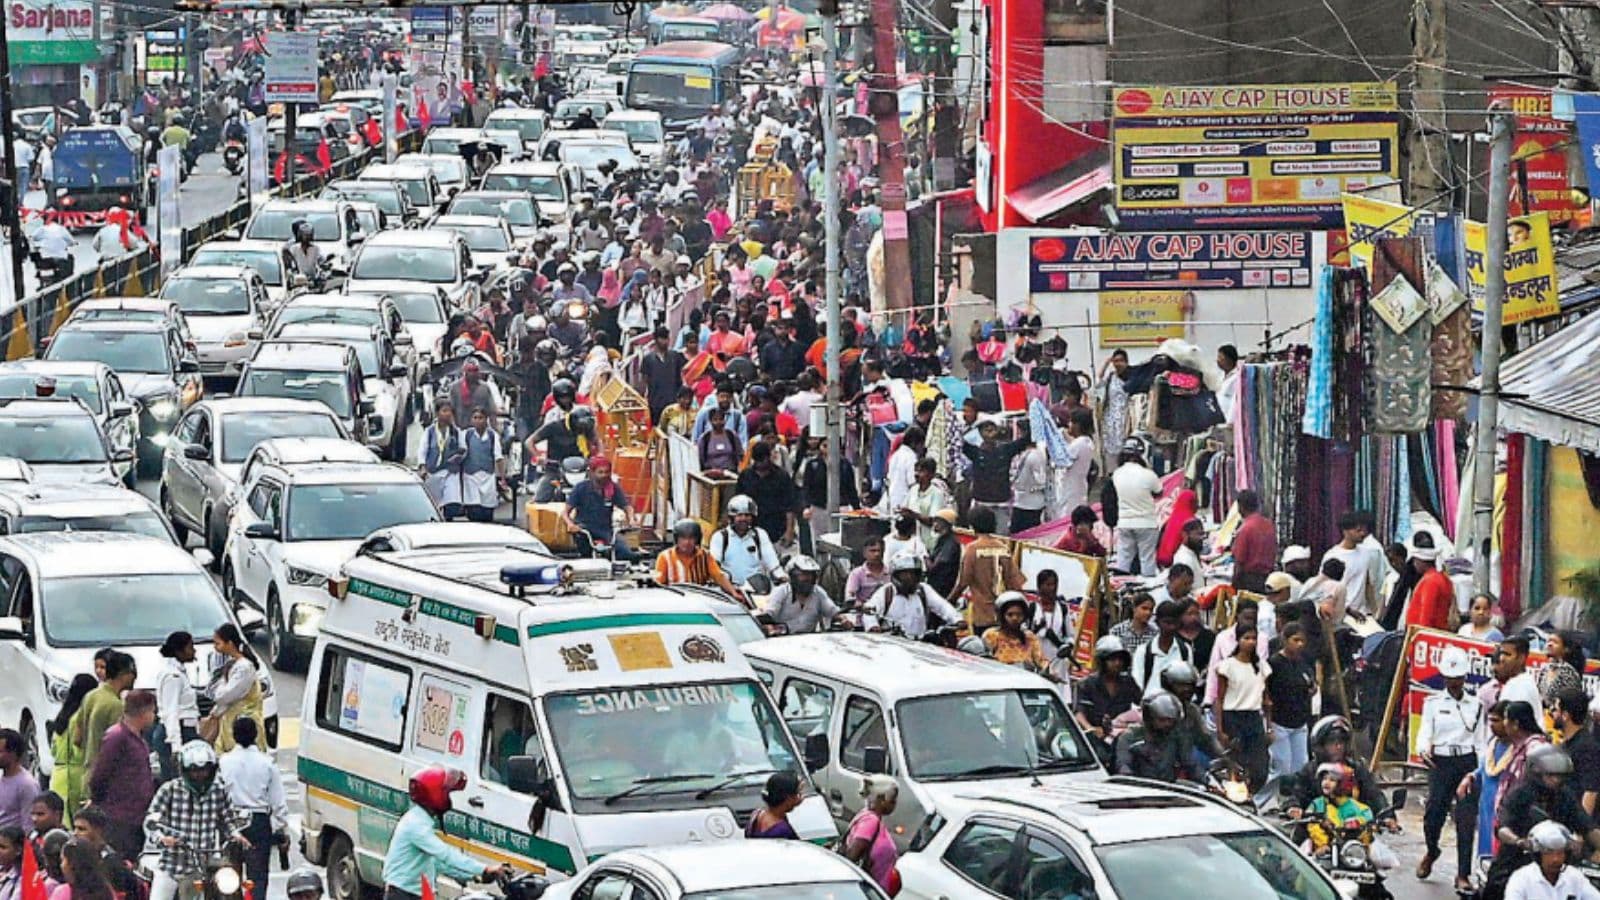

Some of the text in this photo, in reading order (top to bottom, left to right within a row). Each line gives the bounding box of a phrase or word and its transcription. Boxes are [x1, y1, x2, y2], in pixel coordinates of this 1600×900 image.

[11, 3, 92, 32] Sarjana
[1162, 90, 1215, 108] AJAY
[1222, 89, 1266, 107] CAP
[1275, 87, 1350, 106] HOUSE
[1157, 118, 1184, 127] Style,
[1187, 117, 1226, 125] Comfort
[1236, 116, 1262, 124] Value
[1265, 115, 1278, 123] All
[1280, 115, 1308, 123] Under
[1137, 189, 1178, 198] JOCKEY
[1073, 232, 1306, 261] AJAY CAP HOUSE
[423, 702, 450, 736] 108
